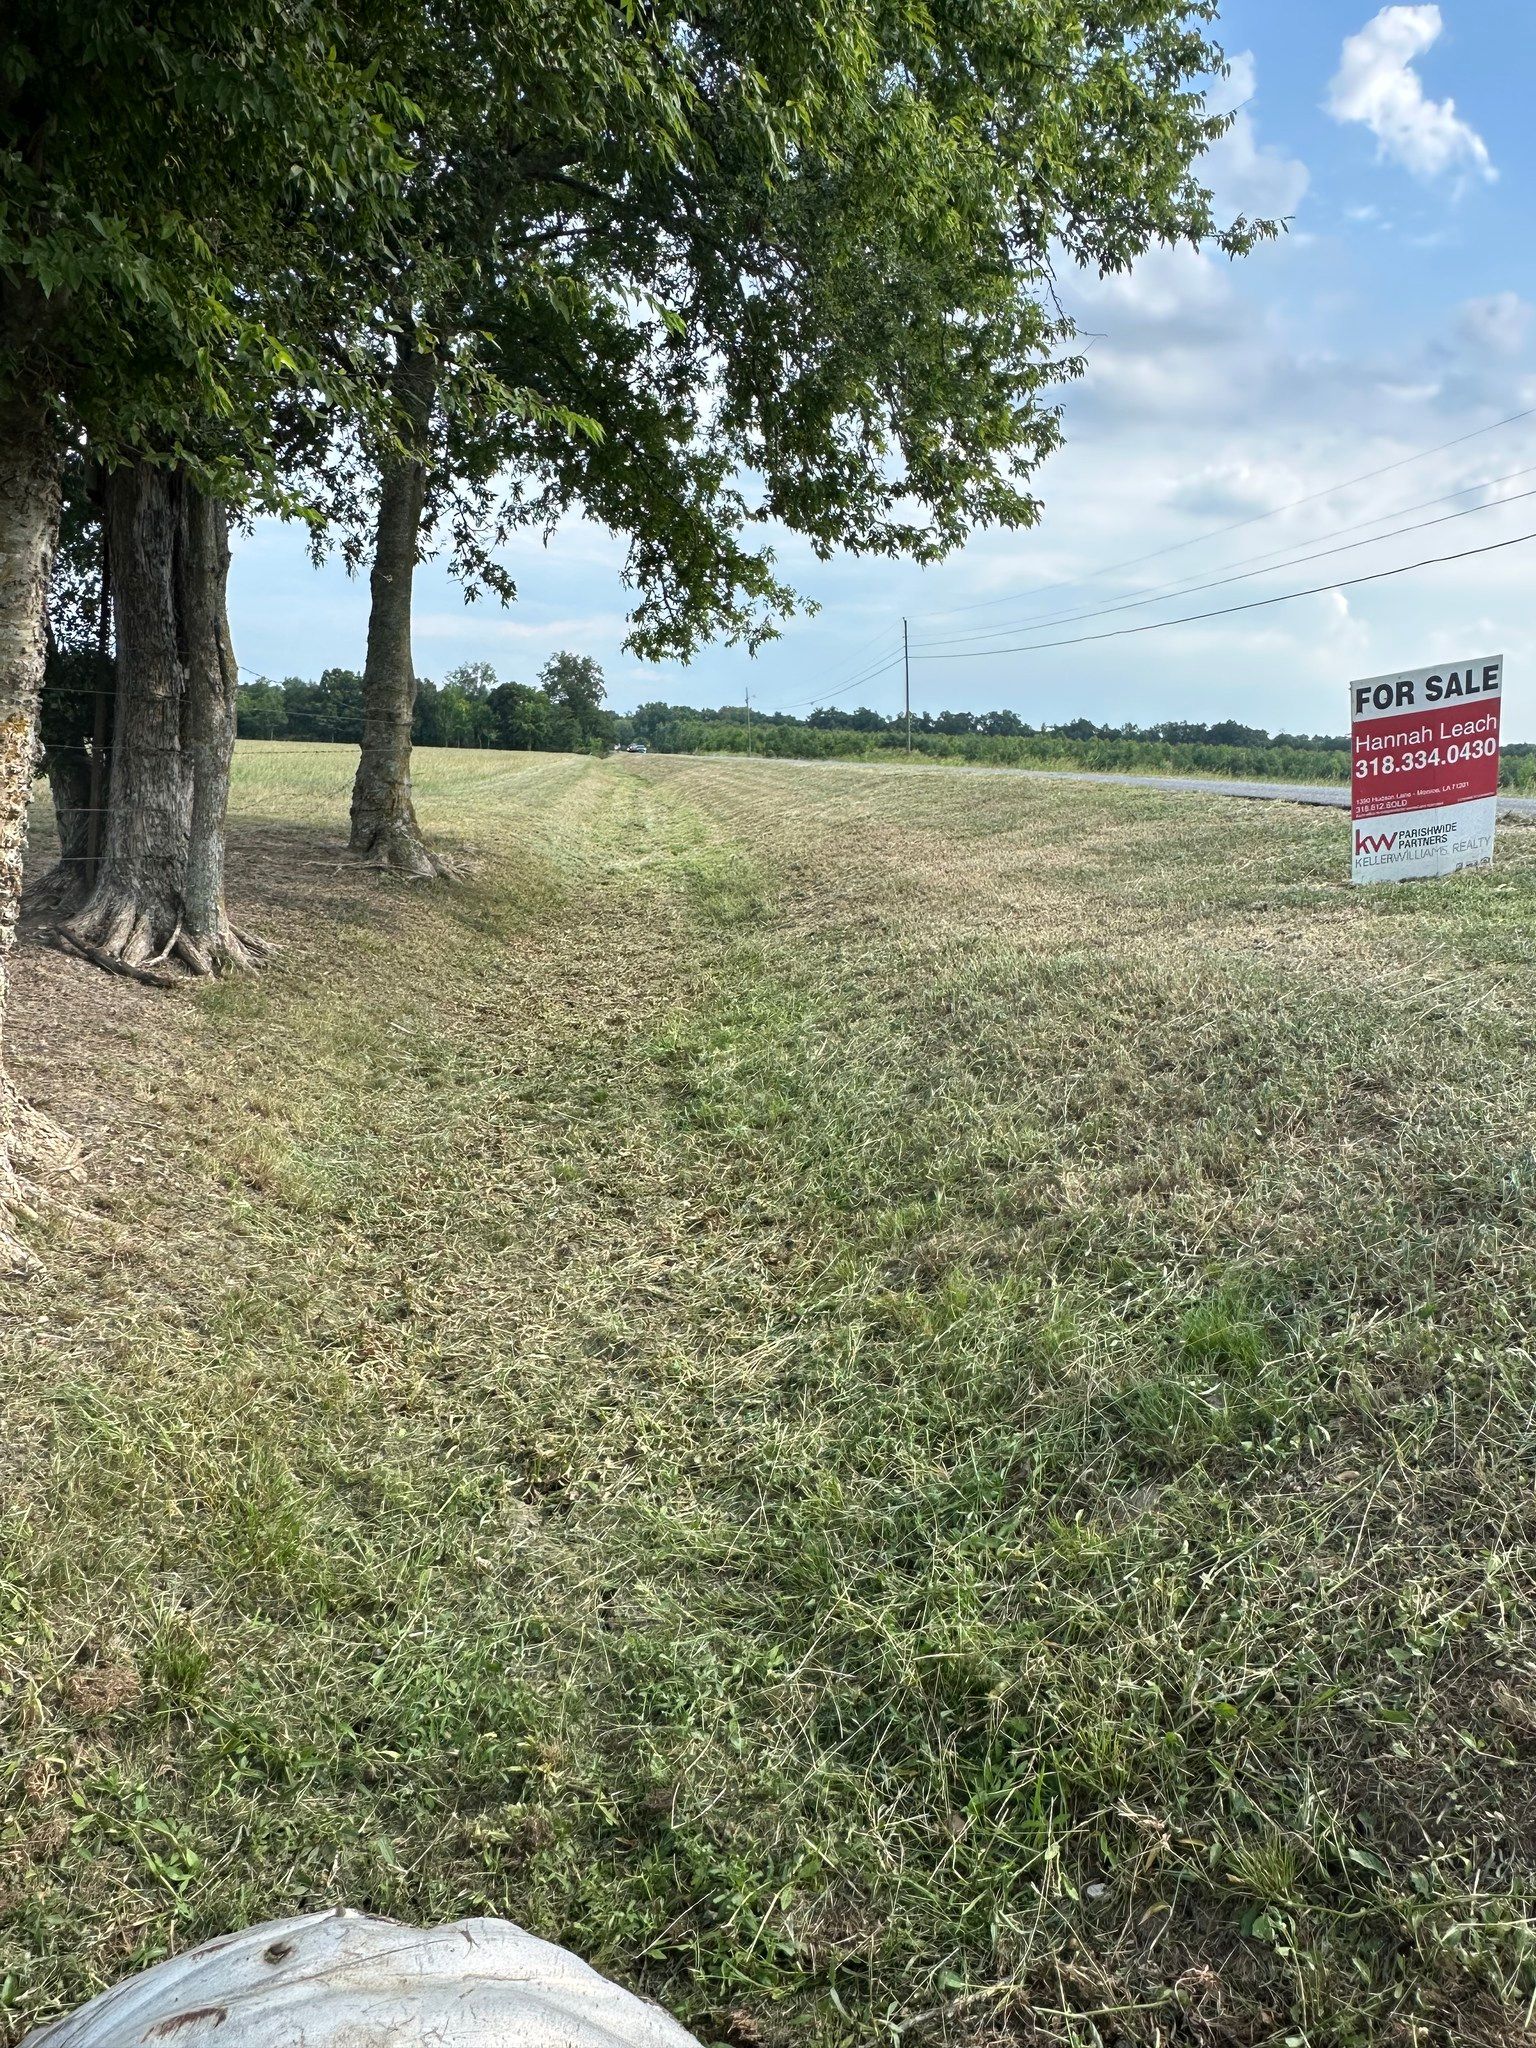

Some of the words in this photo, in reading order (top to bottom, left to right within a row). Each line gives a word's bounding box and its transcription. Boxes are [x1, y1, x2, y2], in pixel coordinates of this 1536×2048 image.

[1356, 681, 1414, 715] FOR
[1425, 664, 1499, 702] SALE
[1355, 726, 1433, 753] Hannah
[1440, 714, 1497, 739] Leach
[1355, 737, 1496, 779] 318.334.0430
[1355, 829, 1397, 856] kw
[1398, 822, 1457, 840] PARISHWIDE
[1398, 834, 1448, 849] PARTNERS
[1452, 835, 1492, 854] REALTY
